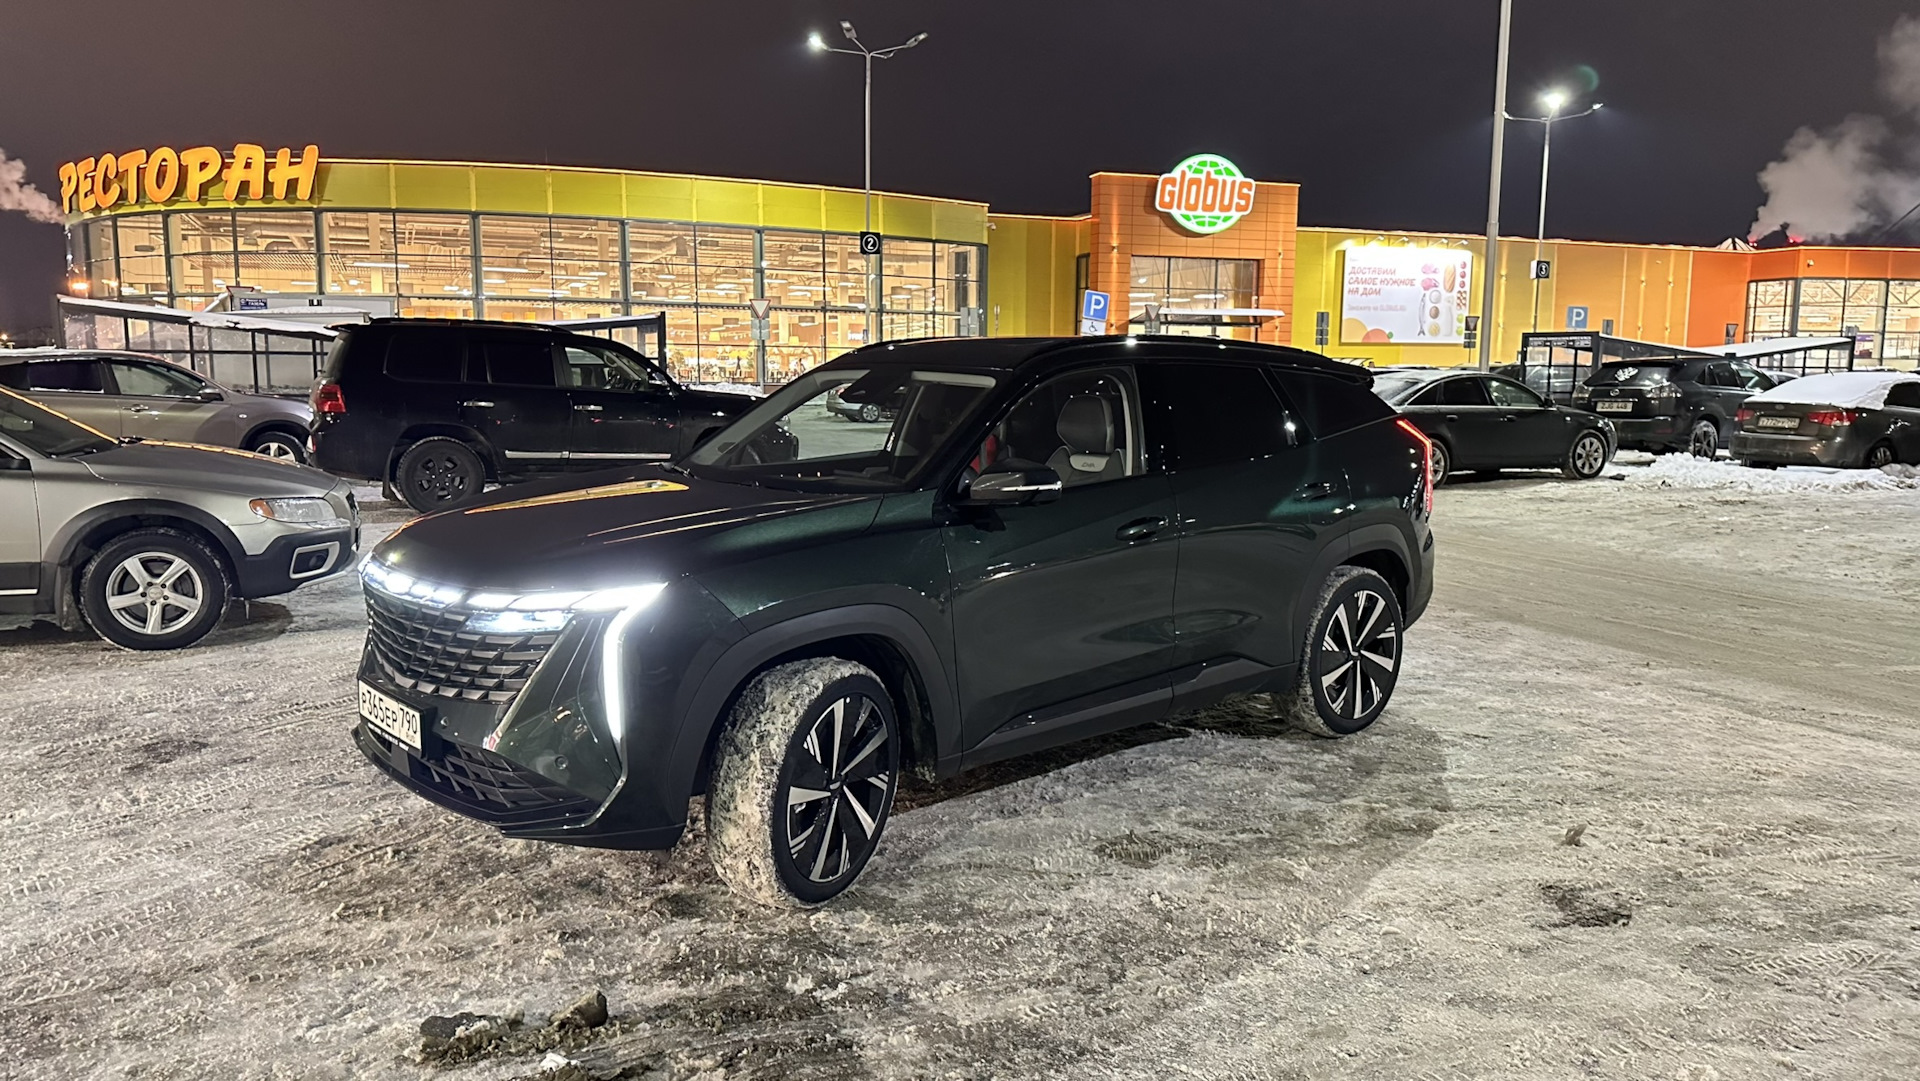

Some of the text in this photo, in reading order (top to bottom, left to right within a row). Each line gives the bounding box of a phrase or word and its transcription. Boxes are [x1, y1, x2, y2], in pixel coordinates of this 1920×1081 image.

[59, 143, 319, 214] РЕСТОРАН
[867, 237, 874, 250] 2
[1349, 266, 1396, 276] ДОСТАВИМ
[1348, 276, 1416, 287] САМОЕ НУЖНОЕ
[1347, 287, 1382, 297] НА ДОМ
[1089, 294, 1105, 316] P
[1572, 308, 1585, 327] P
